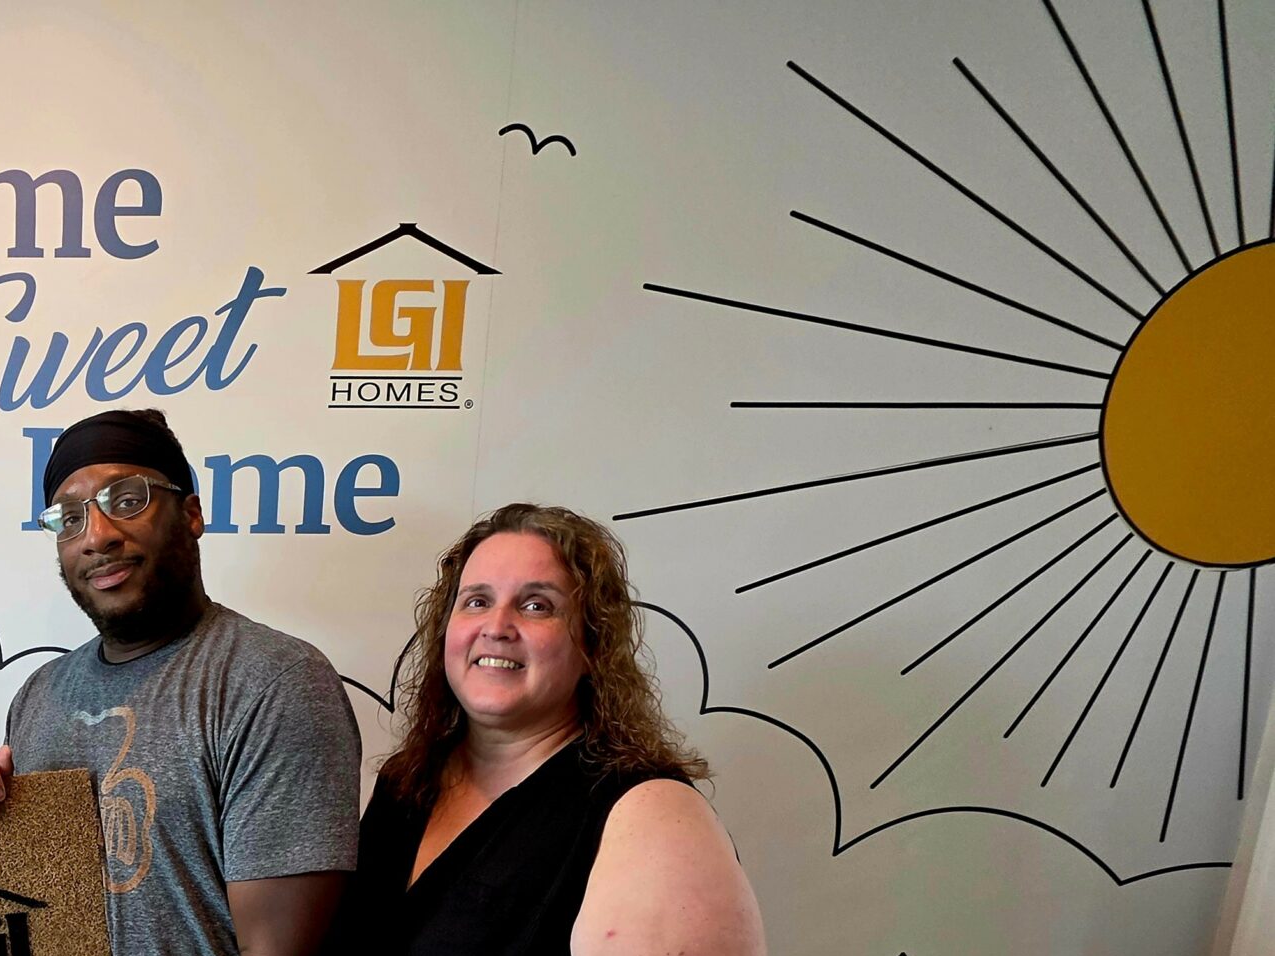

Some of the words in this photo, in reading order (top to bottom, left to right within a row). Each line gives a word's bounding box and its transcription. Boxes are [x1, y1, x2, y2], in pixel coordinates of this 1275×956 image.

[331, 279, 471, 371] LGI
[331, 381, 459, 402] HOMES
[21, 427, 401, 535] me
